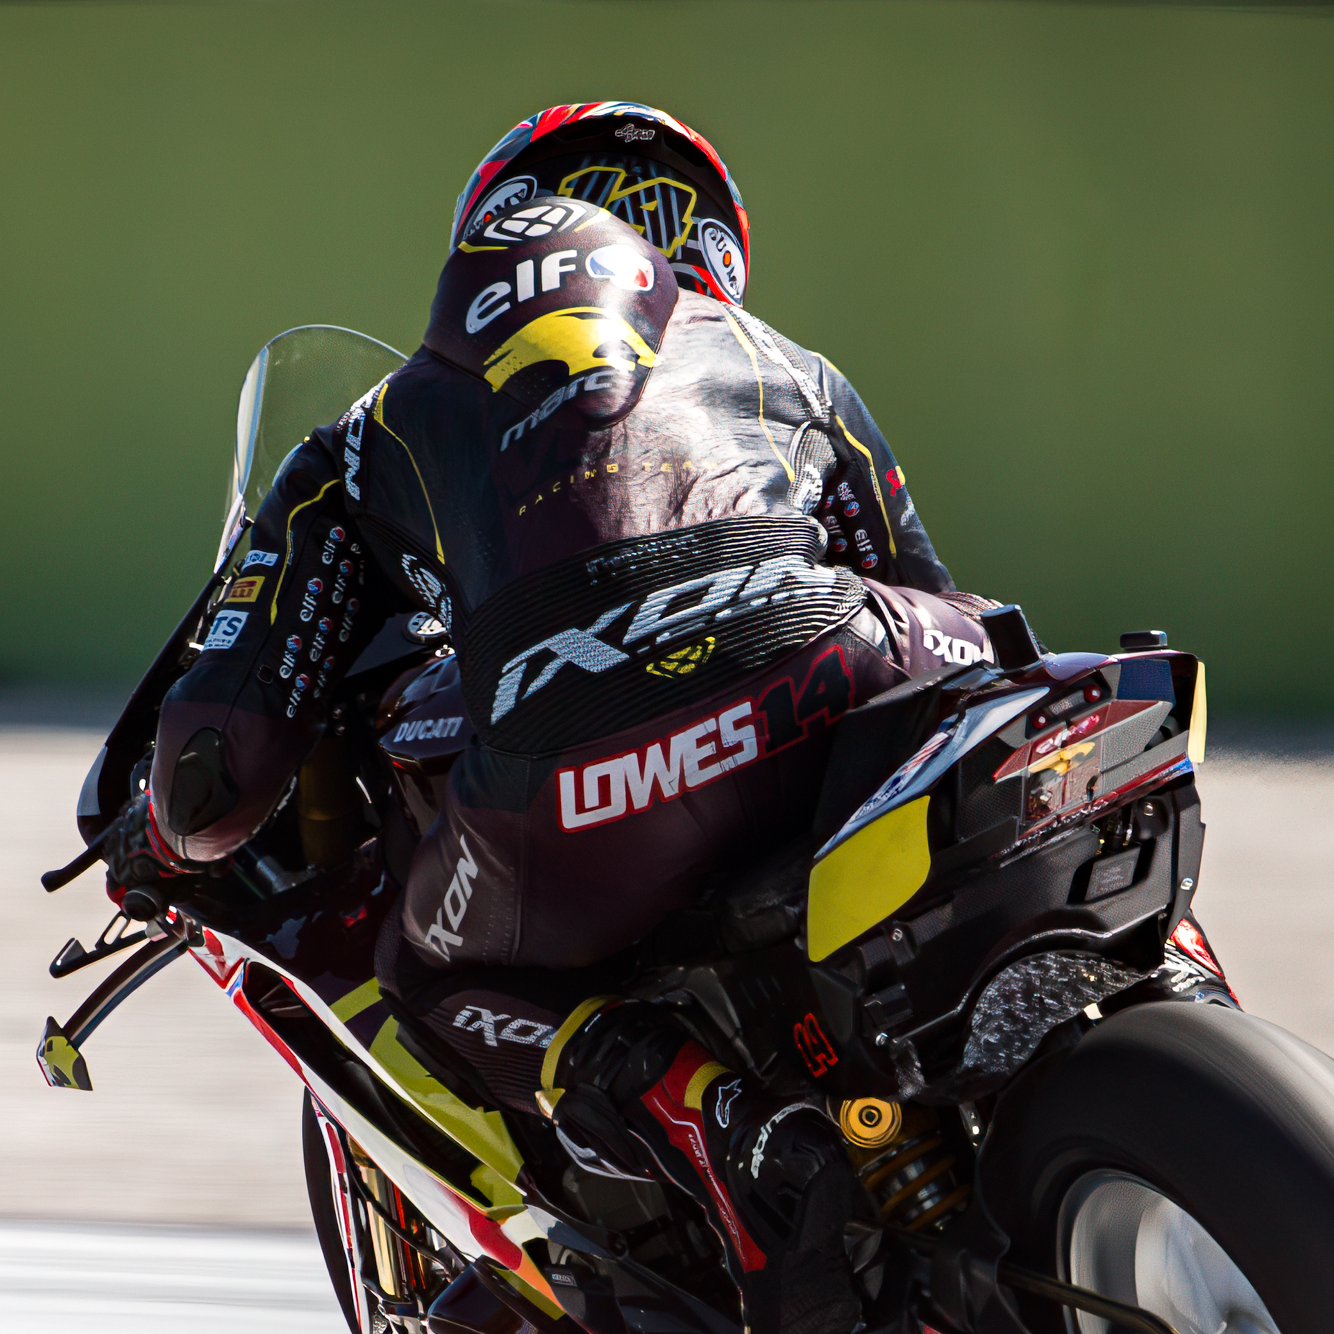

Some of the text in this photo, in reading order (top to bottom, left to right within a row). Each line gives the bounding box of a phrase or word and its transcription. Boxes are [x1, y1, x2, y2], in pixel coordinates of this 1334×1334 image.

[465, 250, 579, 334] elf
[321, 539, 337, 566] elf
[854, 528, 874, 552] elf
[331, 573, 347, 605] elf
[299, 592, 318, 623] elf
[309, 631, 327, 663] elf
[278, 650, 297, 679] elf
[286, 687, 302, 719] elf
[393, 715, 464, 743] DUCATI
[556, 643, 855, 832] LOWES 14
